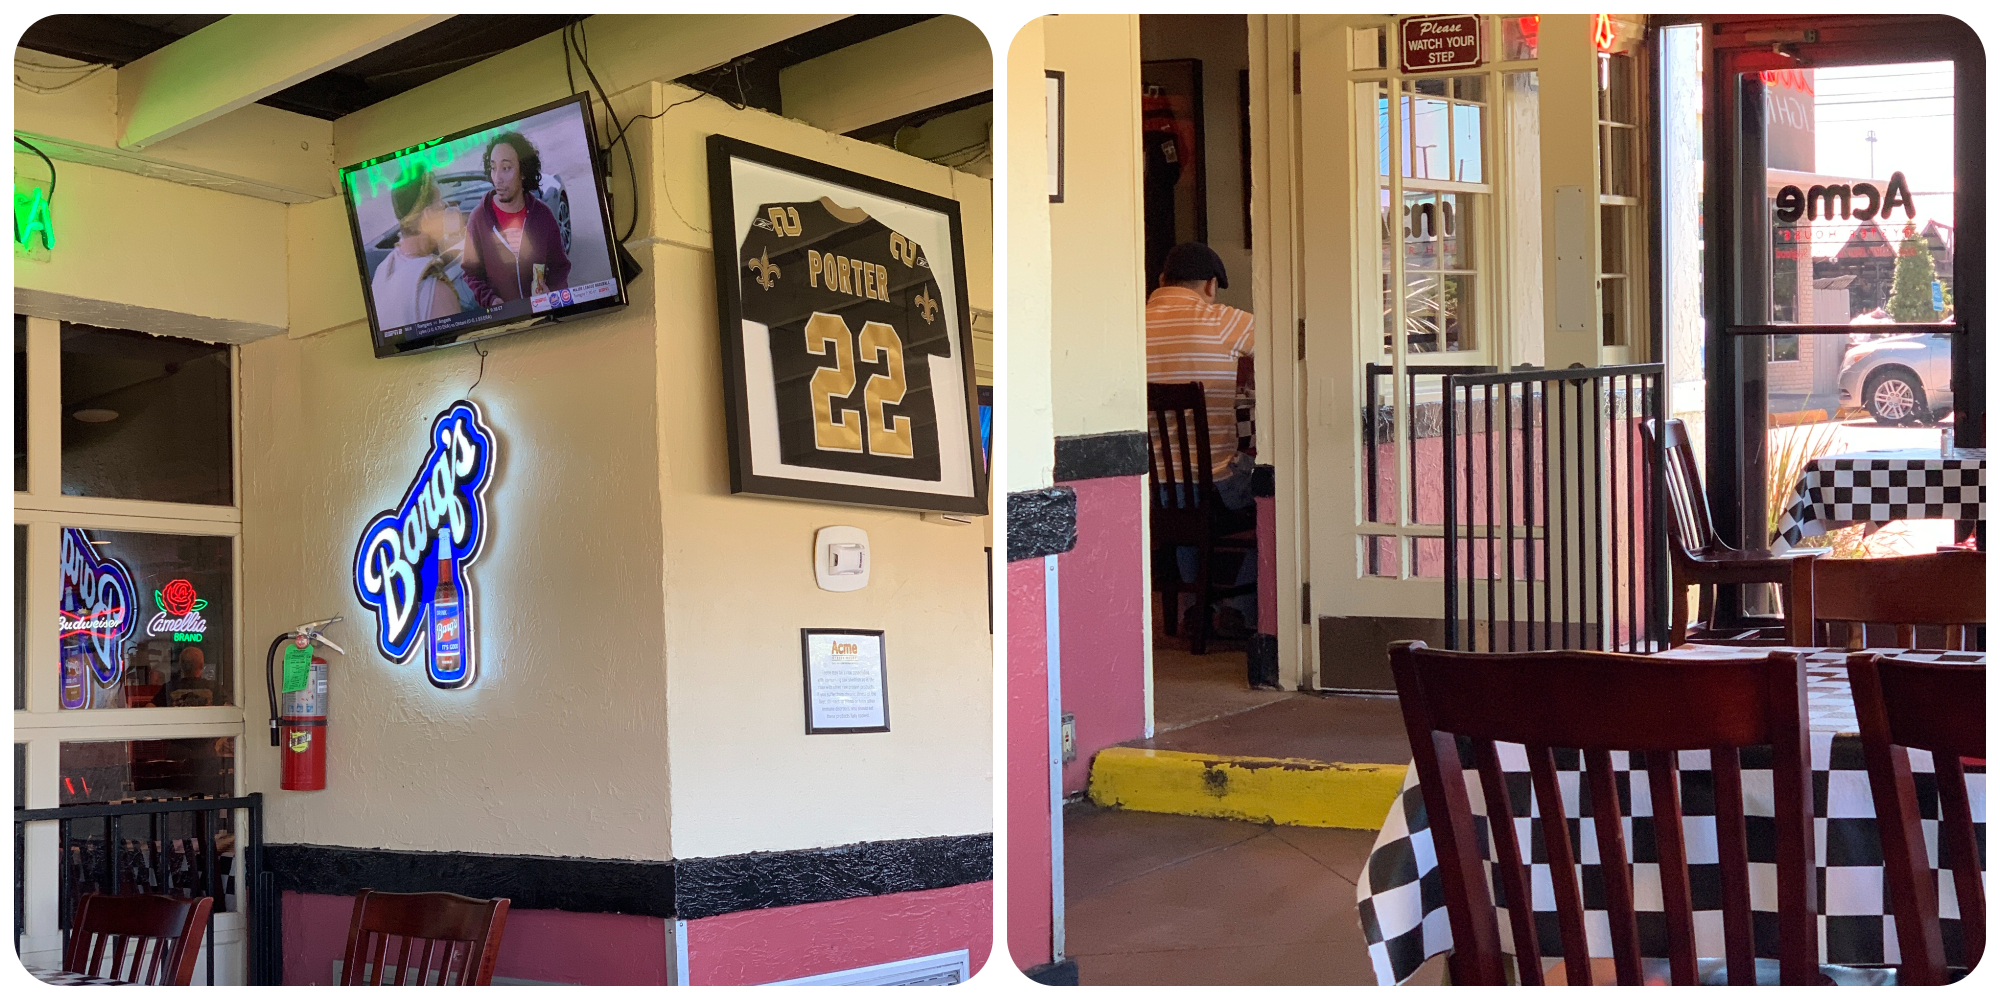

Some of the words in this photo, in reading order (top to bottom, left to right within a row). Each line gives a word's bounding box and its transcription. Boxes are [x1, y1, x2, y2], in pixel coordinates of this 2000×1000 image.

[1420, 22, 1462, 36] Please
[1408, 38, 1443, 51] WATCH
[1446, 35, 1475, 47] YOUR
[1428, 51, 1455, 63] STEP
[808, 249, 890, 303] PORTER
[805, 311, 914, 458] 22
[364, 418, 476, 643] Barq's
[59, 616, 122, 631] Budweiser
[147, 611, 207, 637] Camellia
[436, 618, 458, 640] Barq's
[174, 632, 203, 643] BRAND
[832, 640, 857, 654] Acme
